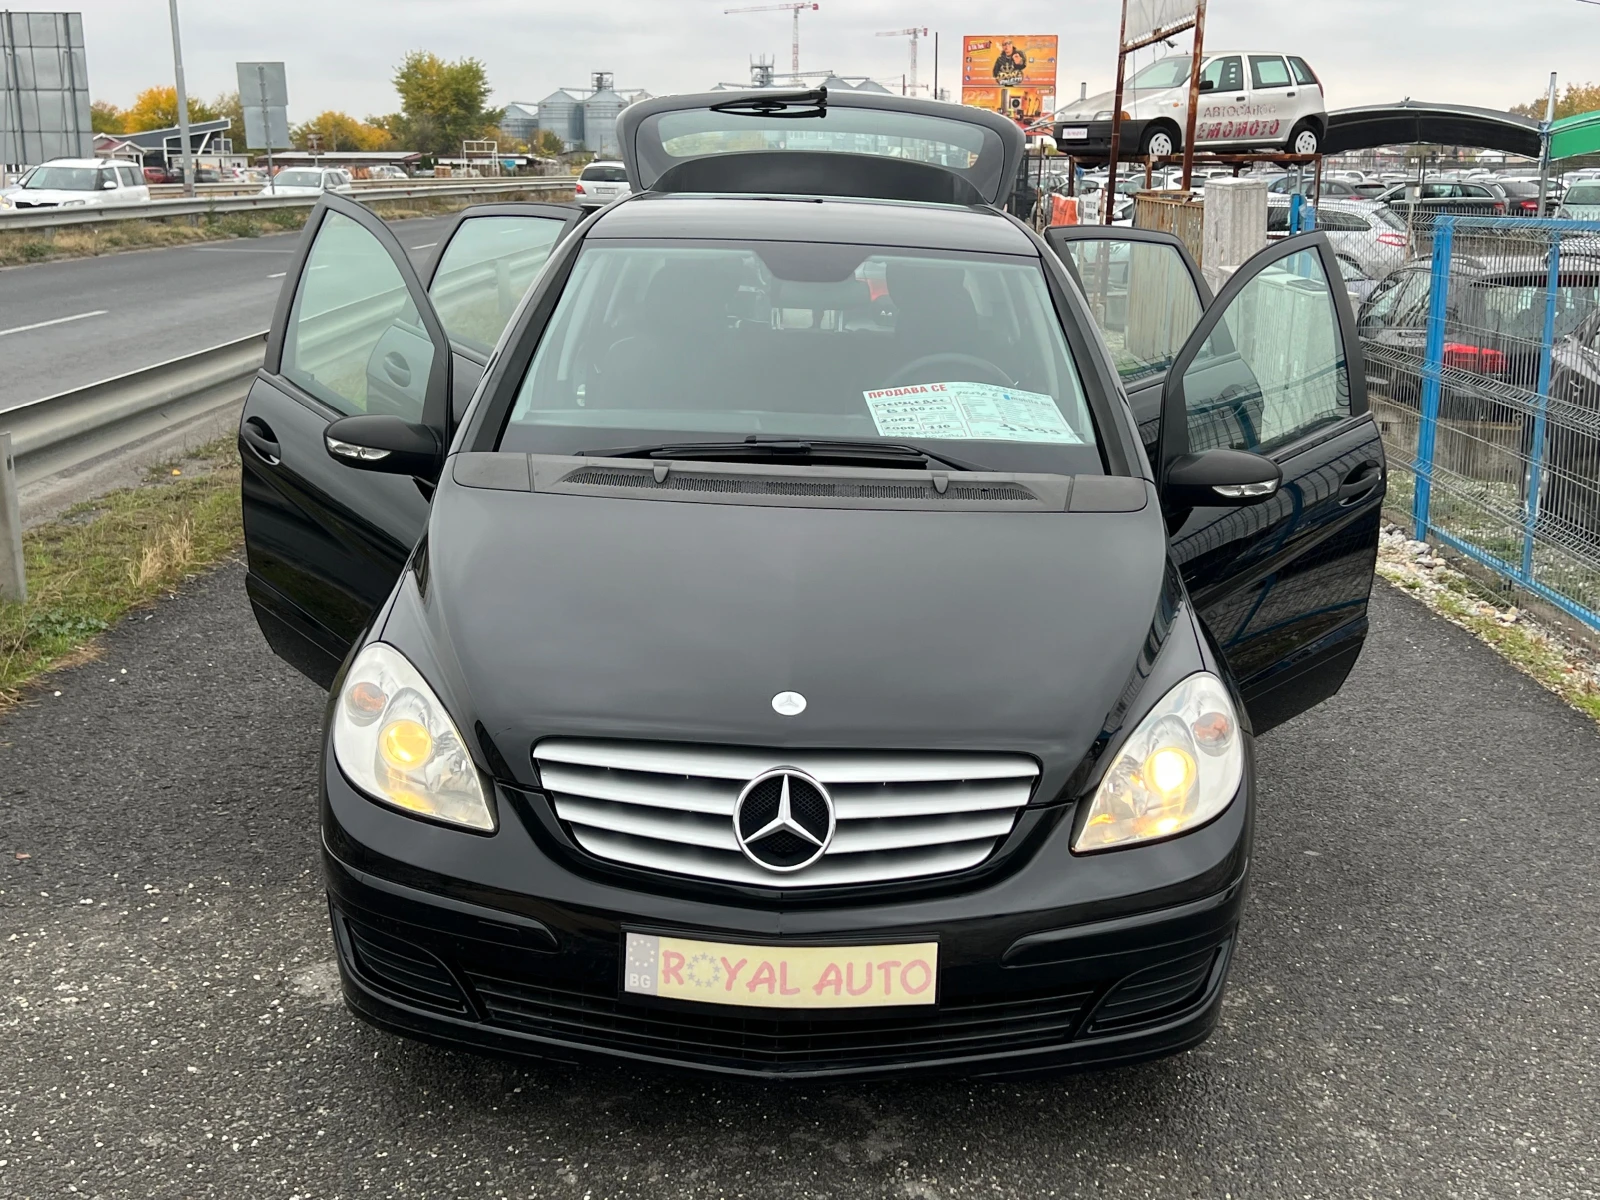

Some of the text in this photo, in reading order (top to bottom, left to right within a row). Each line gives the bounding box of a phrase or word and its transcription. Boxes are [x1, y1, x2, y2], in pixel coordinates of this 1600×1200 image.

[867, 384, 948, 399] ПРОДАВА СЕ
[628, 972, 652, 988] BG
[811, 958, 933, 997] AUTO
